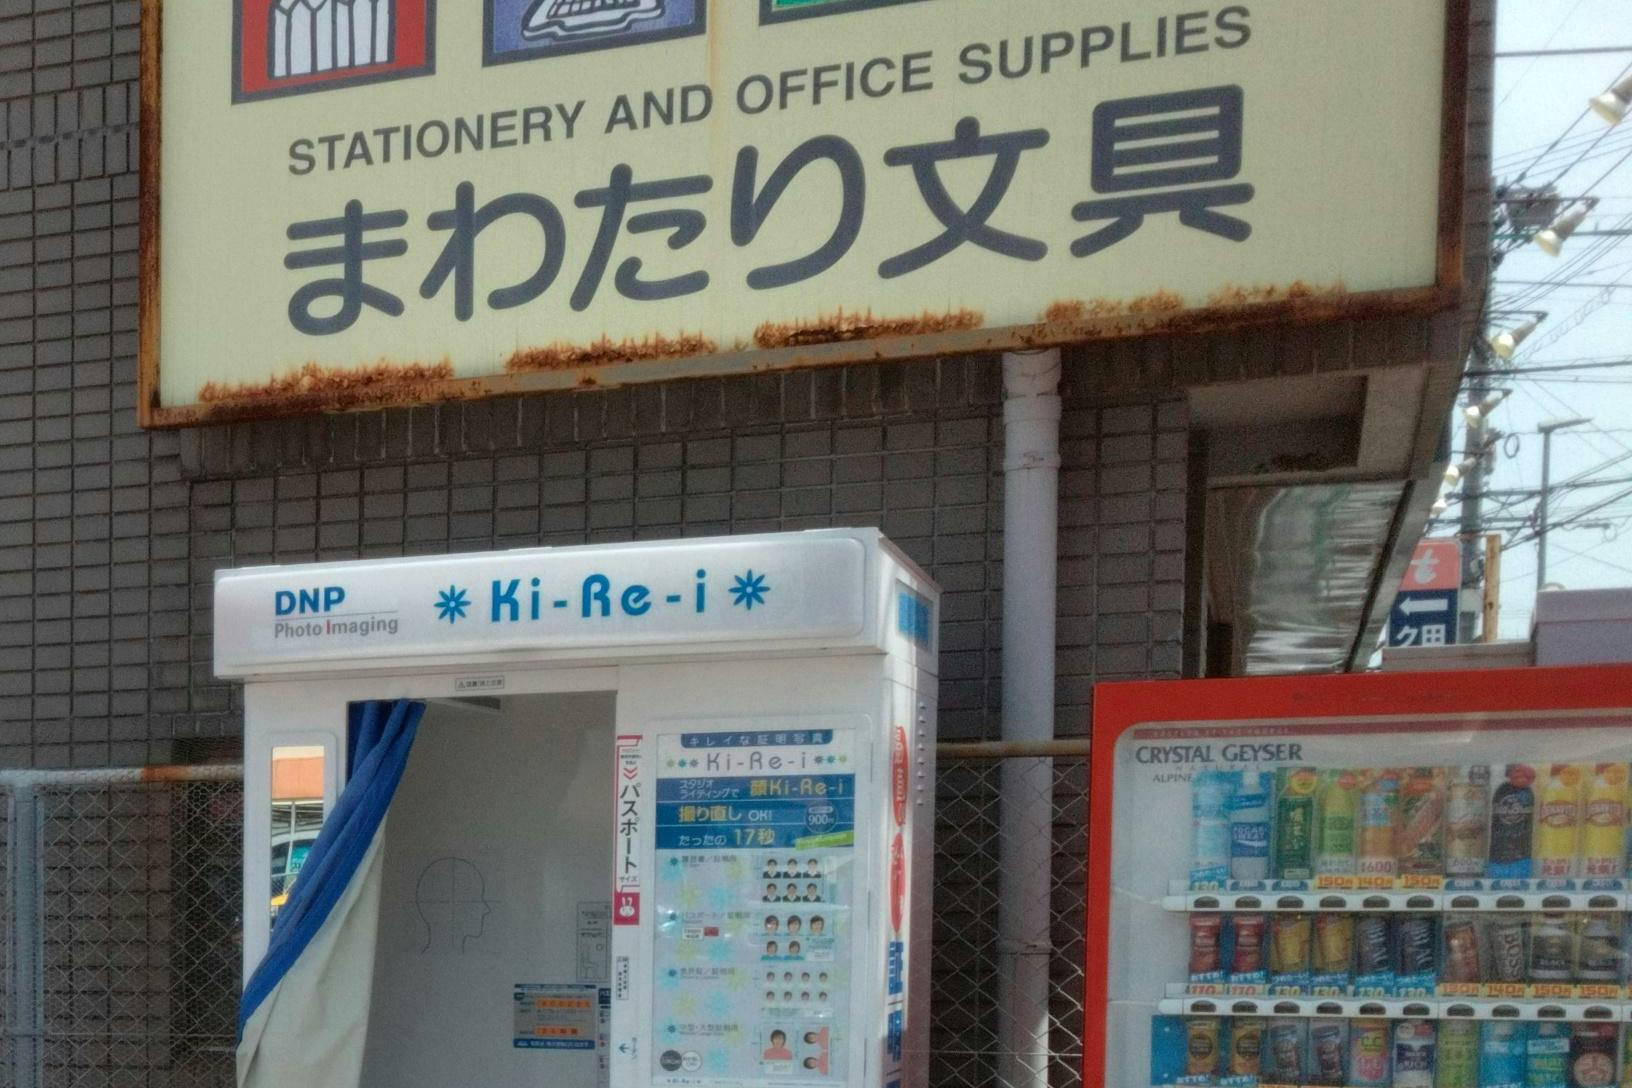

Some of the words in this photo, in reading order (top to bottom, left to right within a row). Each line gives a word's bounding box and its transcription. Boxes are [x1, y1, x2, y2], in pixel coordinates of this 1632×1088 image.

[288, 100, 587, 176] STATIONERY
[604, 82, 713, 135] AND
[735, 50, 935, 117] OFFICE
[958, 5, 1253, 85] SUPPLIES
[283, 84, 1255, 336] まわたり文具
[275, 586, 346, 616] DNP
[491, 569, 707, 622] Ki-Re-i
[274, 620, 323, 638] Photo
[326, 614, 398, 637] Imaging
[688, 731, 825, 746] キレイな証明写真
[1135, 745, 1214, 764] CRYSTAL
[1222, 743, 1304, 762] GEYSER
[706, 752, 807, 771] Ki-Re-i
[620, 783, 641, 875] パスポート
